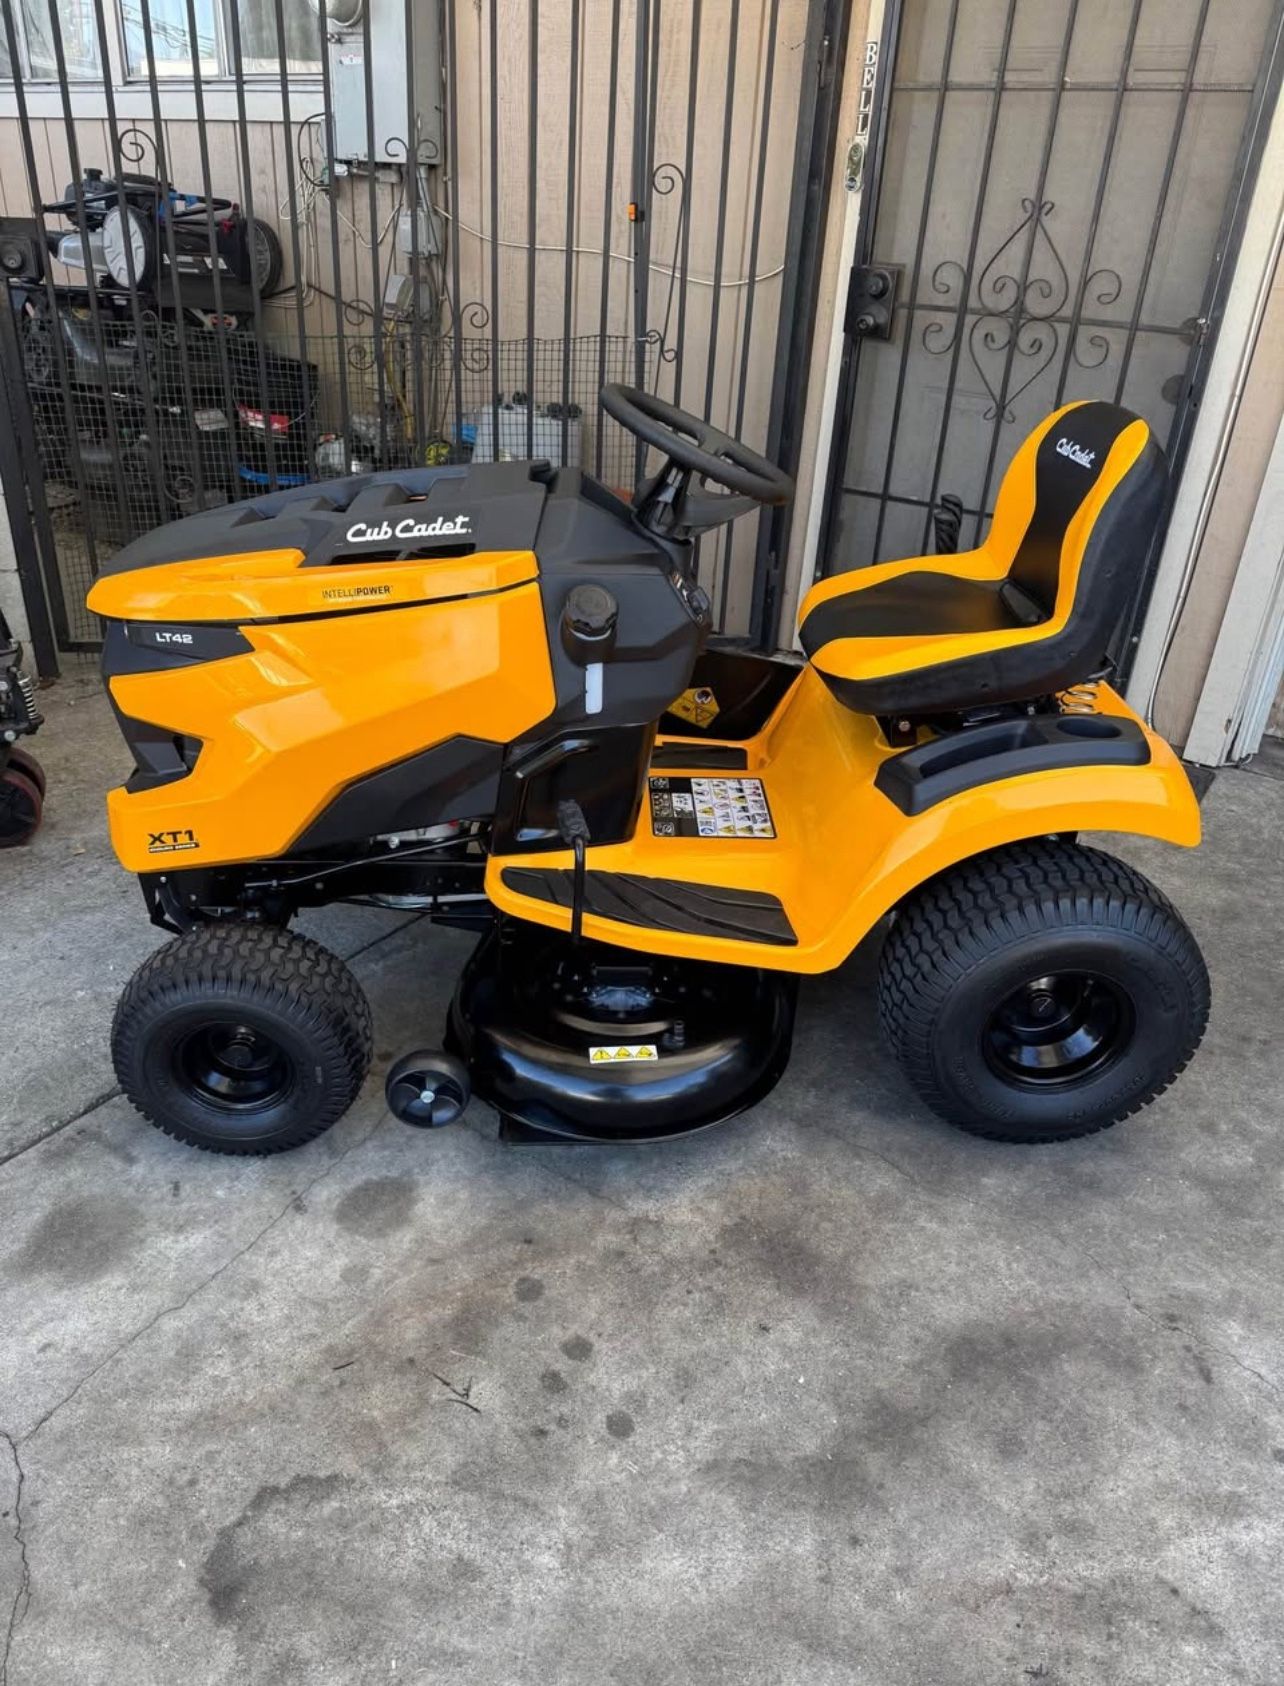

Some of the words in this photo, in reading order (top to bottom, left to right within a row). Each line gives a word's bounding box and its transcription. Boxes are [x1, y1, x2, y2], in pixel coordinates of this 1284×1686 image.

[856, 43, 877, 135] BELL
[346, 521, 393, 543] Cub
[395, 515, 470, 538] Cadet
[155, 632, 194, 644] LT42
[148, 829, 195, 846] XT1
